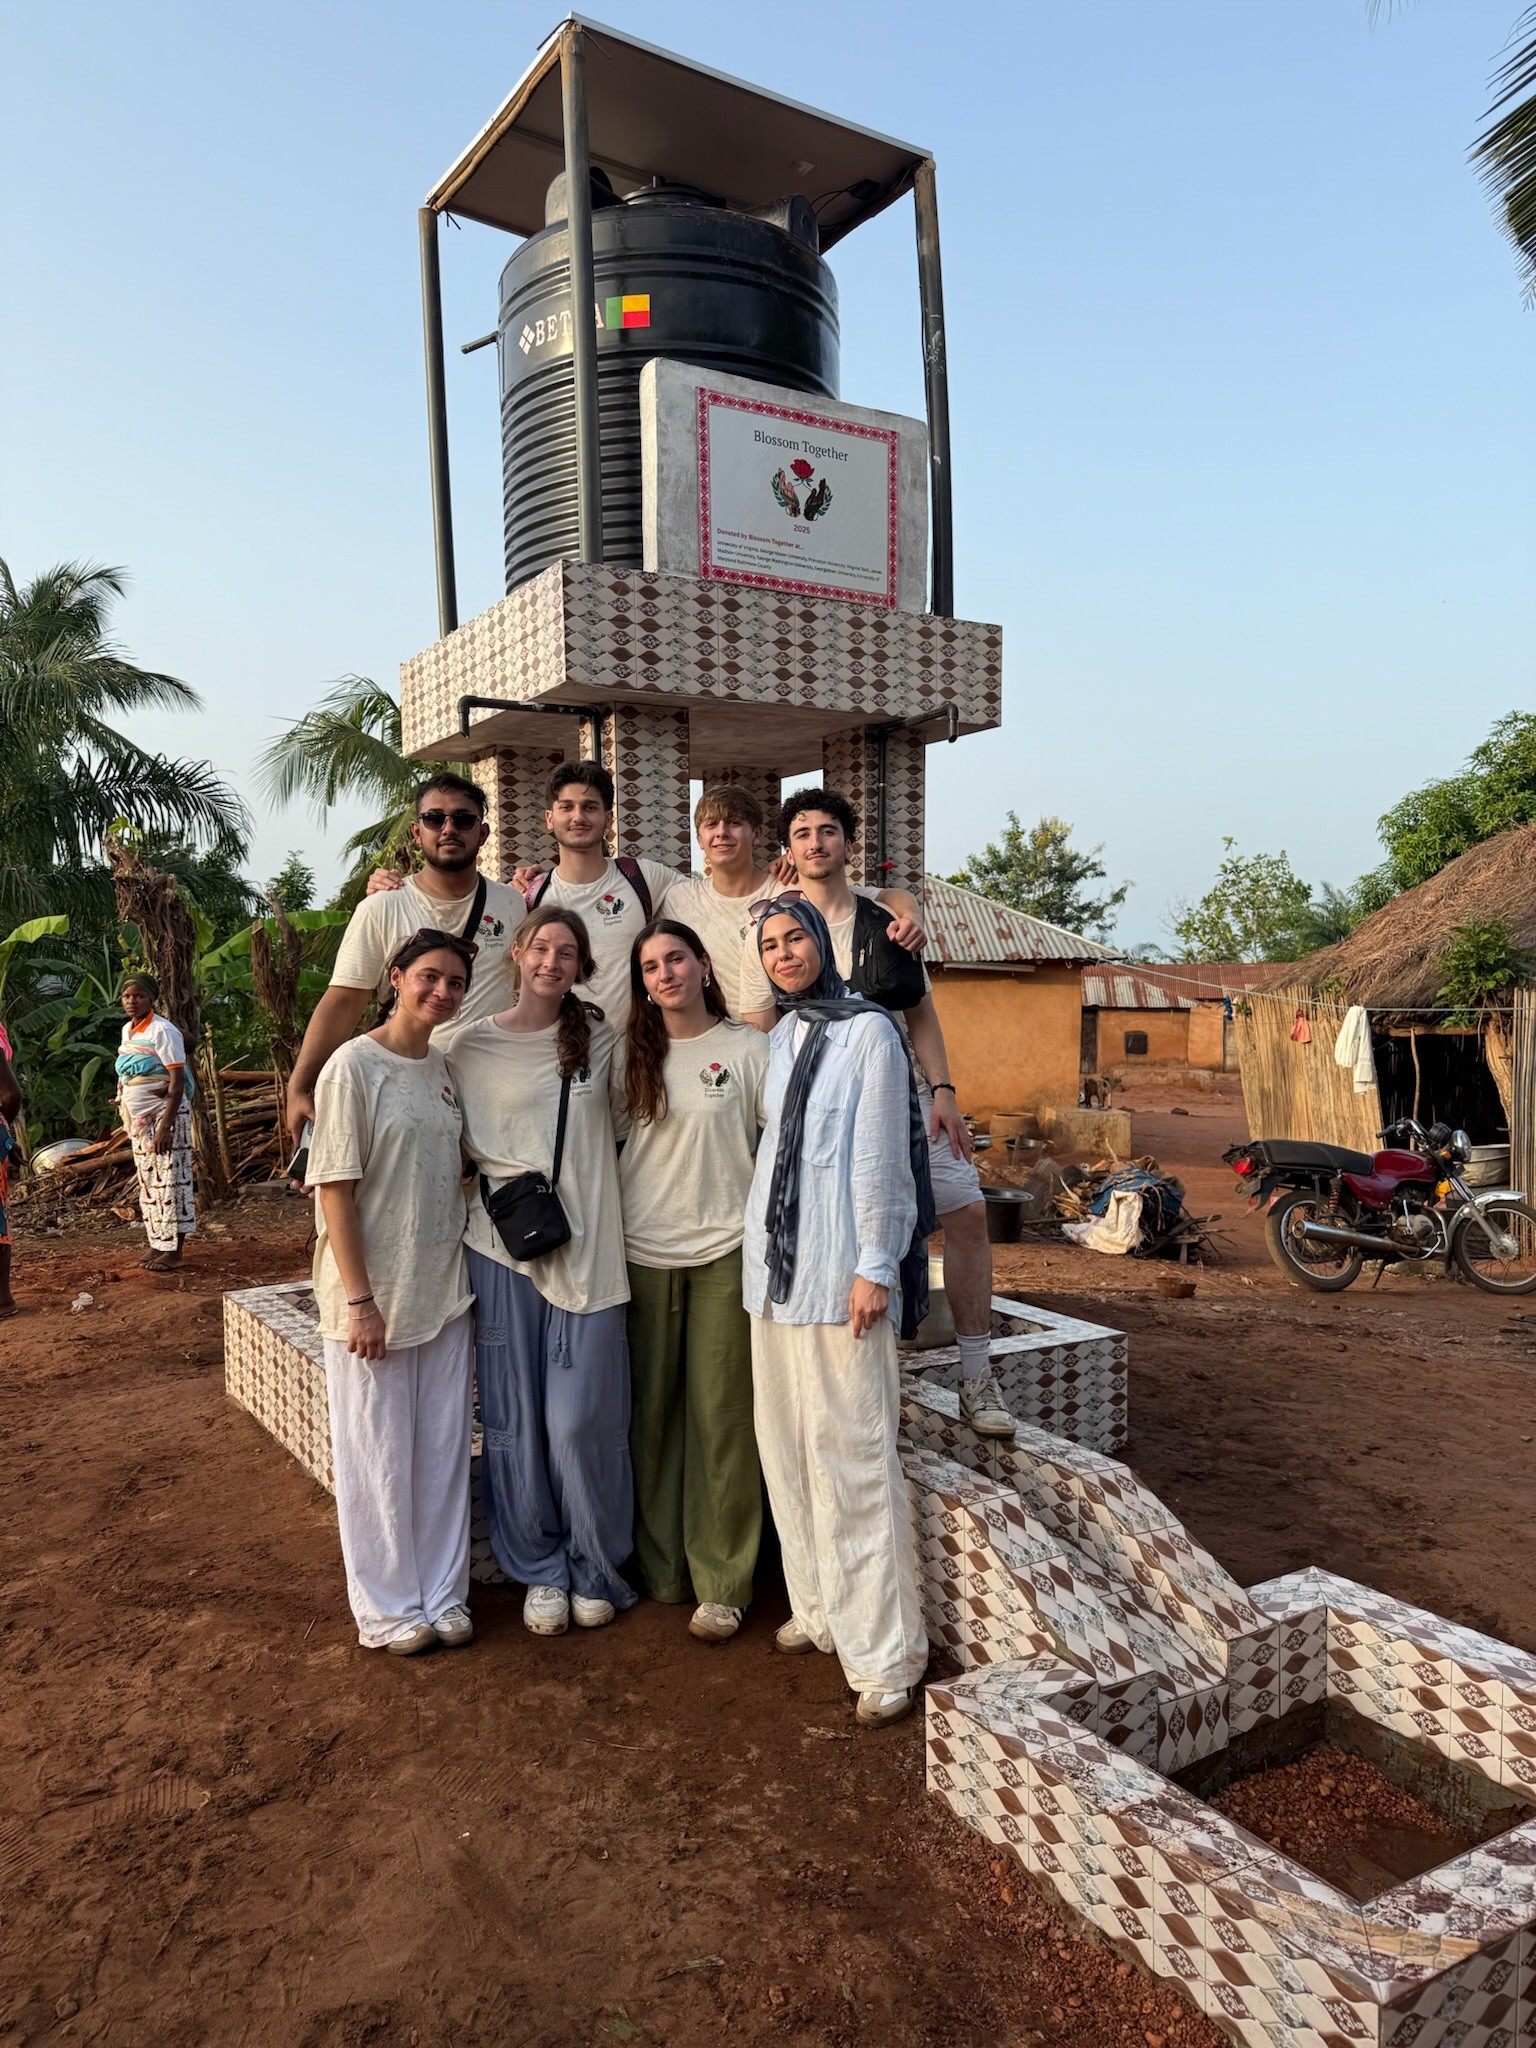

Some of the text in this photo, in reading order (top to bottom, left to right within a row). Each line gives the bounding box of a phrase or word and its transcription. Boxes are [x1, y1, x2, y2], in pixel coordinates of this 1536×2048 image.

[534, 302, 604, 347] BETA
[754, 430, 849, 462] Blossom Together
[717, 528, 740, 537] Donated
[749, 534, 771, 543] Blossom
[772, 538, 794, 548] Together
[793, 524, 811, 534] 2025
[717, 540, 737, 549] University
[808, 557, 826, 565] Princeton
[717, 555, 772, 570] Maryland Baltimore County
[757, 555, 771, 563] George
[771, 558, 794, 567] Washington
[815, 565, 837, 574] Georgetown
